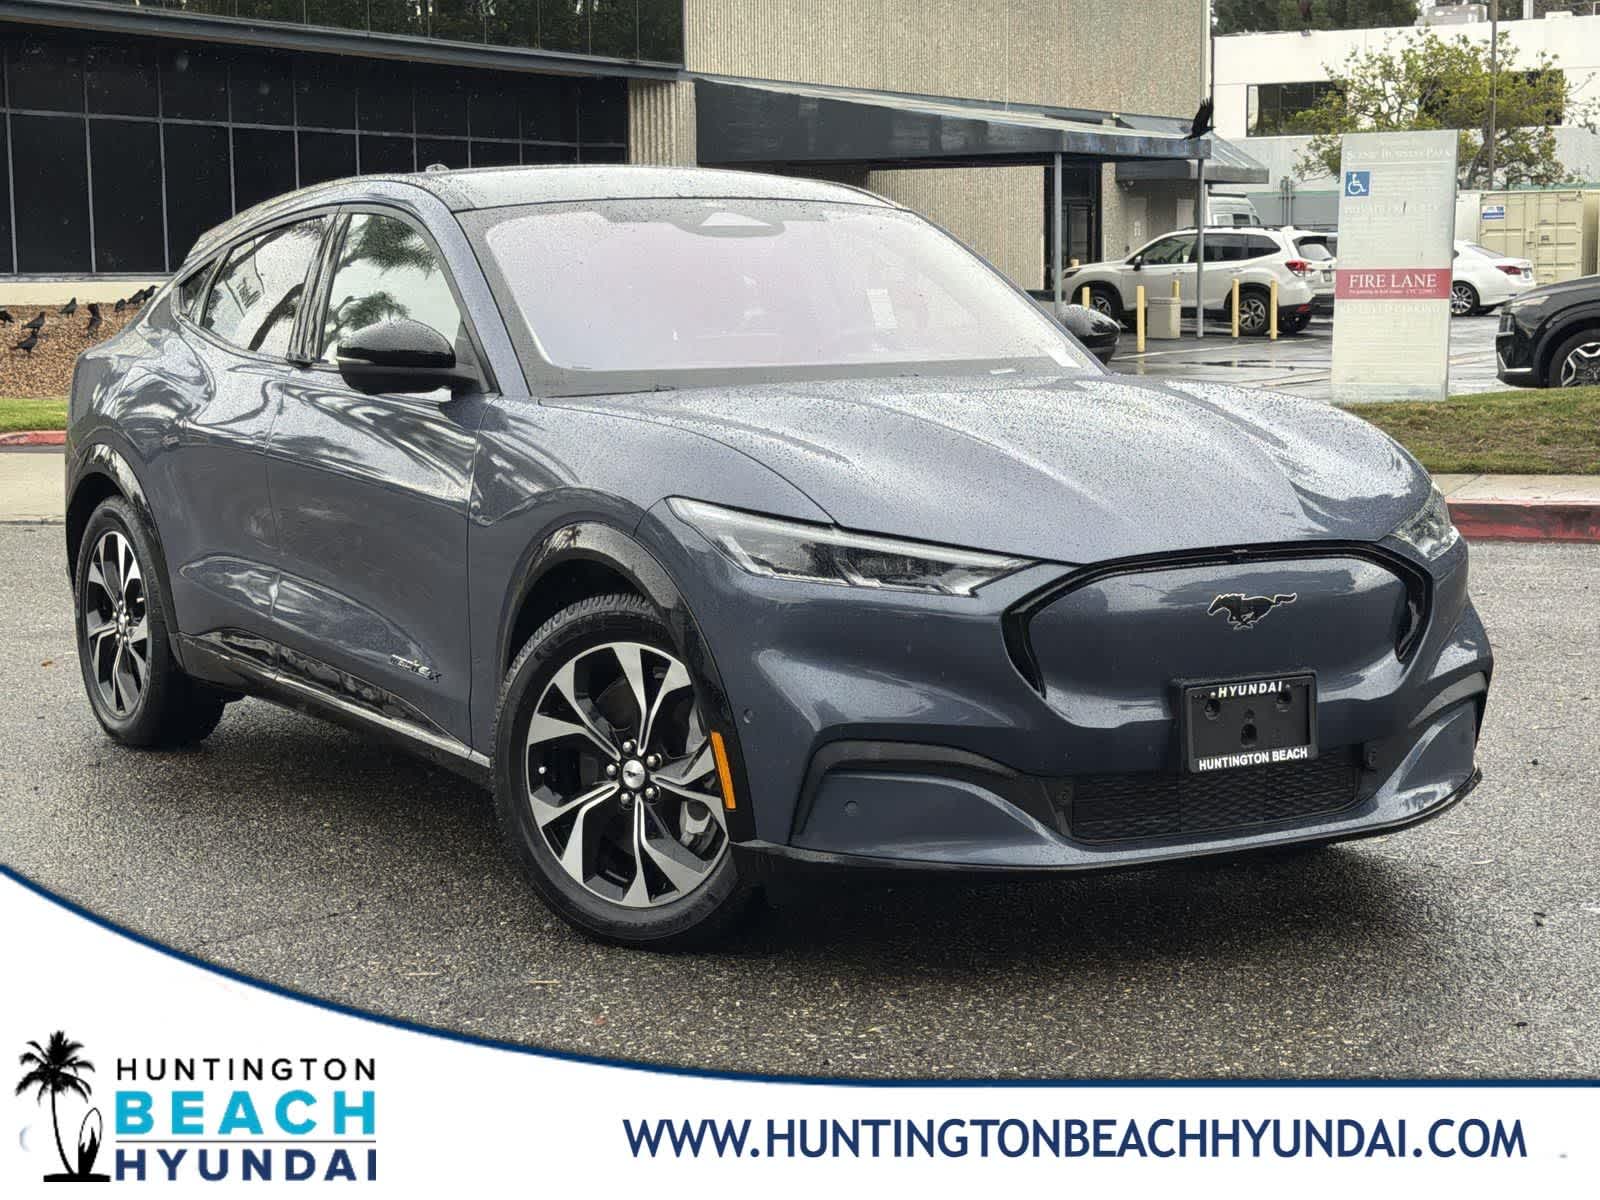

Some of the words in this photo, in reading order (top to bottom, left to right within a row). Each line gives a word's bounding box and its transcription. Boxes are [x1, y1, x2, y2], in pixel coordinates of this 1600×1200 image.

[1348, 274, 1387, 289] FIRE
[1391, 273, 1438, 289] LANE
[1217, 681, 1283, 698] HYUNDAI
[1199, 751, 1270, 771] HUNTINGTON
[1272, 747, 1308, 762] BEACH
